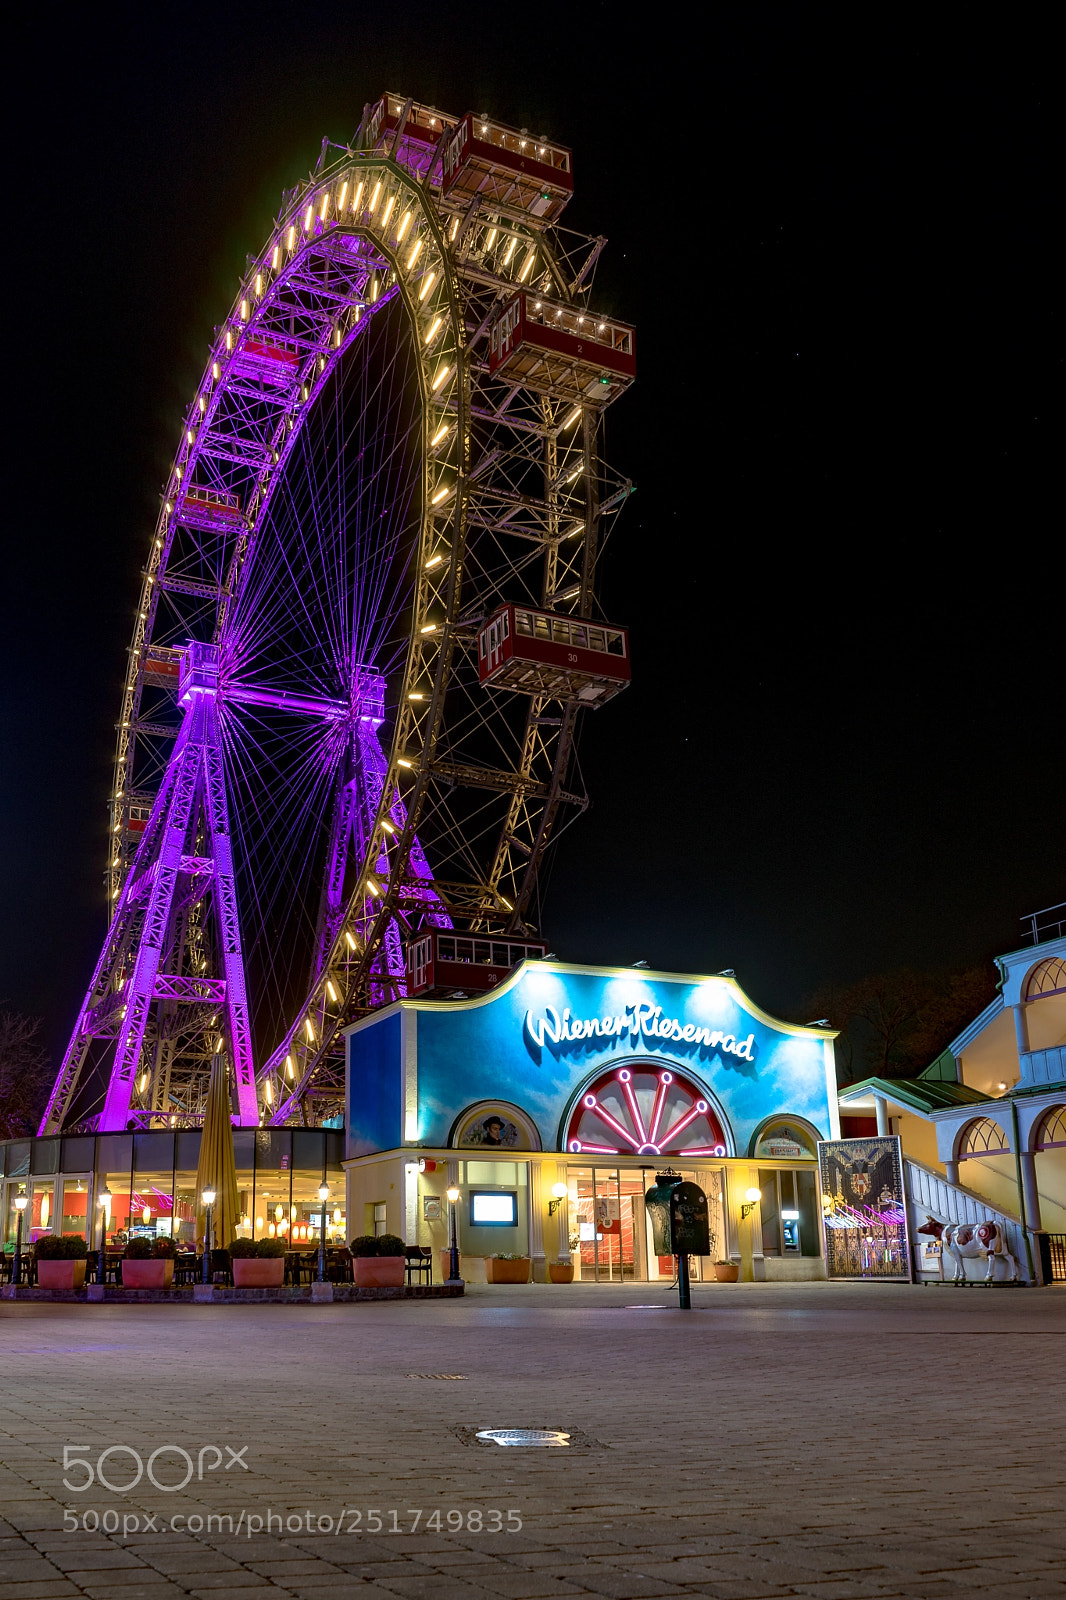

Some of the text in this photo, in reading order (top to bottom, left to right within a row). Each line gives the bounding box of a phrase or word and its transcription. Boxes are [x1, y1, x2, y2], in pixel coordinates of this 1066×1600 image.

[577, 344, 583, 353] 2
[567, 652, 578, 663] 30
[487, 973, 498, 982] 28
[526, 1000, 755, 1062] Wiener Riesenrad
